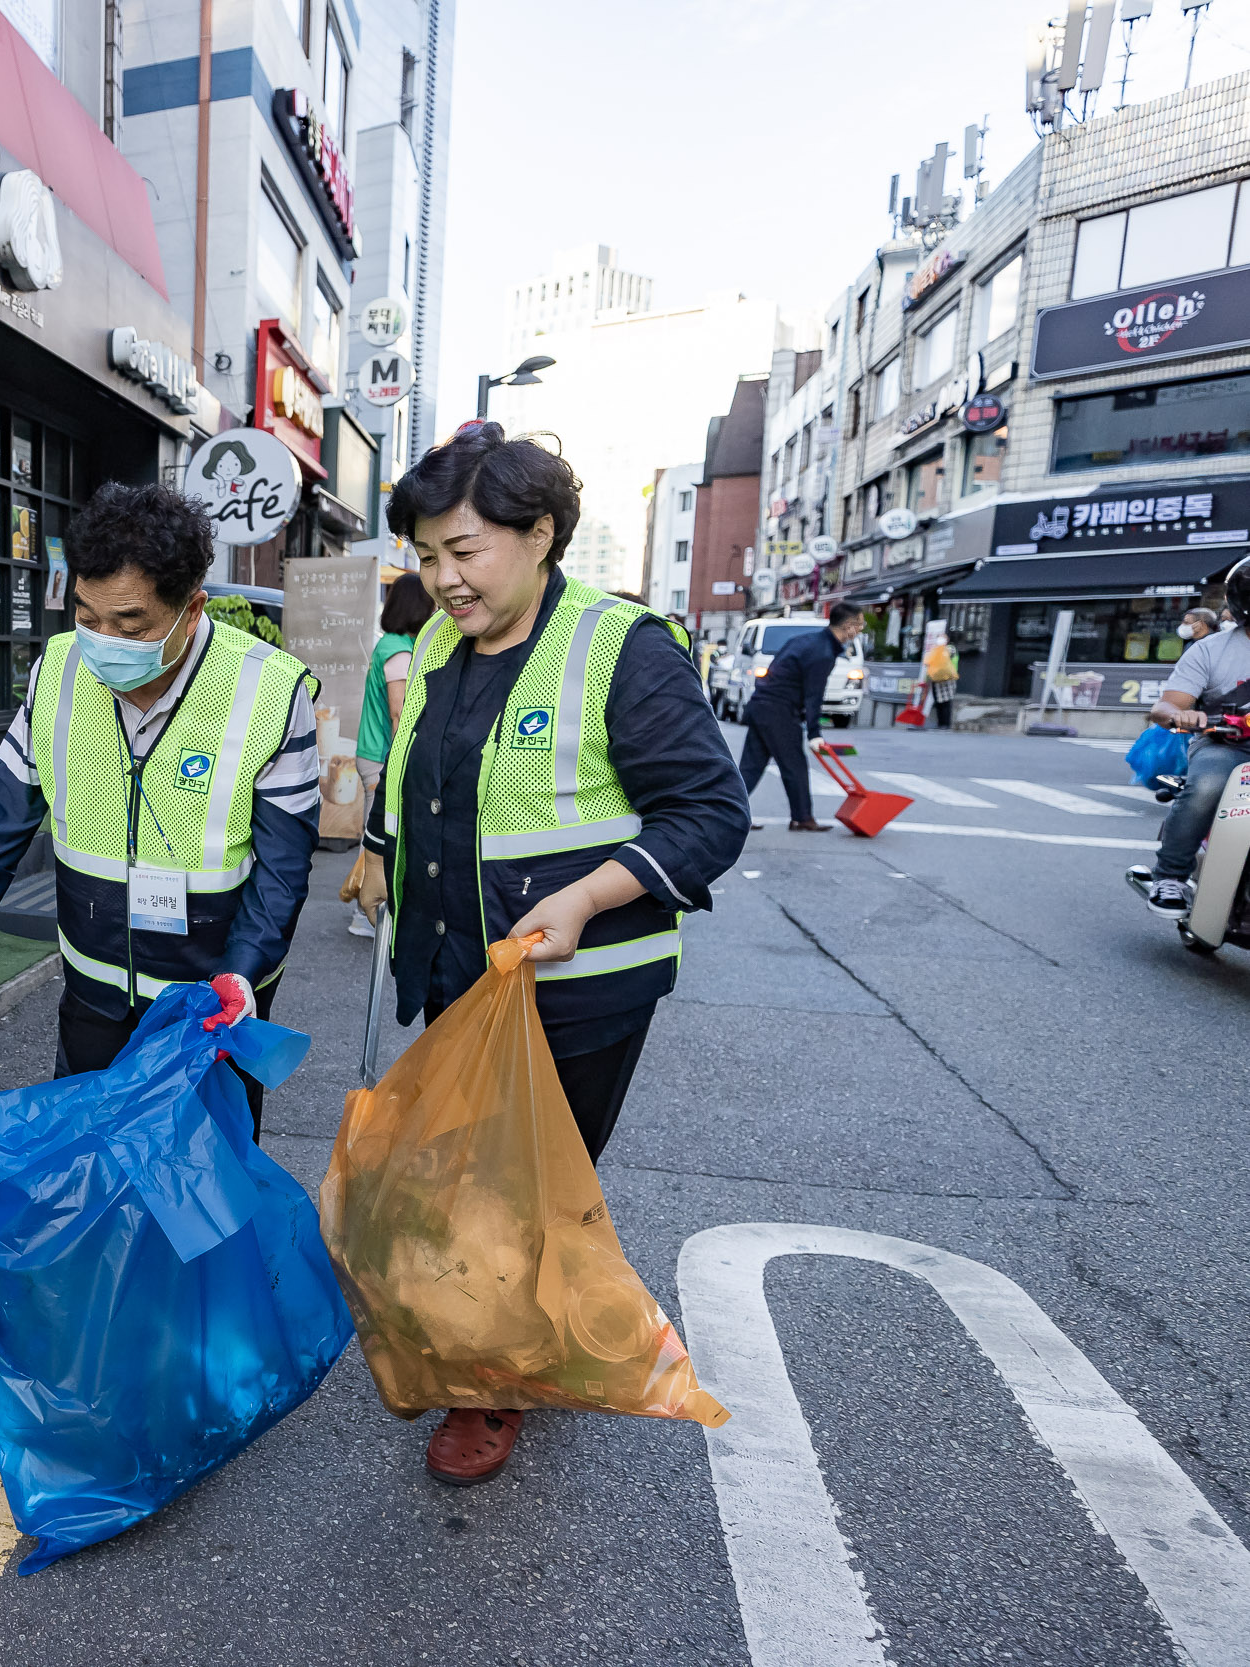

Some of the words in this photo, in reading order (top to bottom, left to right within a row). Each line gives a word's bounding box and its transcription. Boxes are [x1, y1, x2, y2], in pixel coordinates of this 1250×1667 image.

[1113, 295, 1195, 329] Olleh
[371, 359, 398, 384] M
[1072, 493, 1213, 527] 카페인중독
[515, 736, 548, 746] 광진구
[178, 776, 206, 790] 광진구
[150, 895, 177, 910] 김태철
